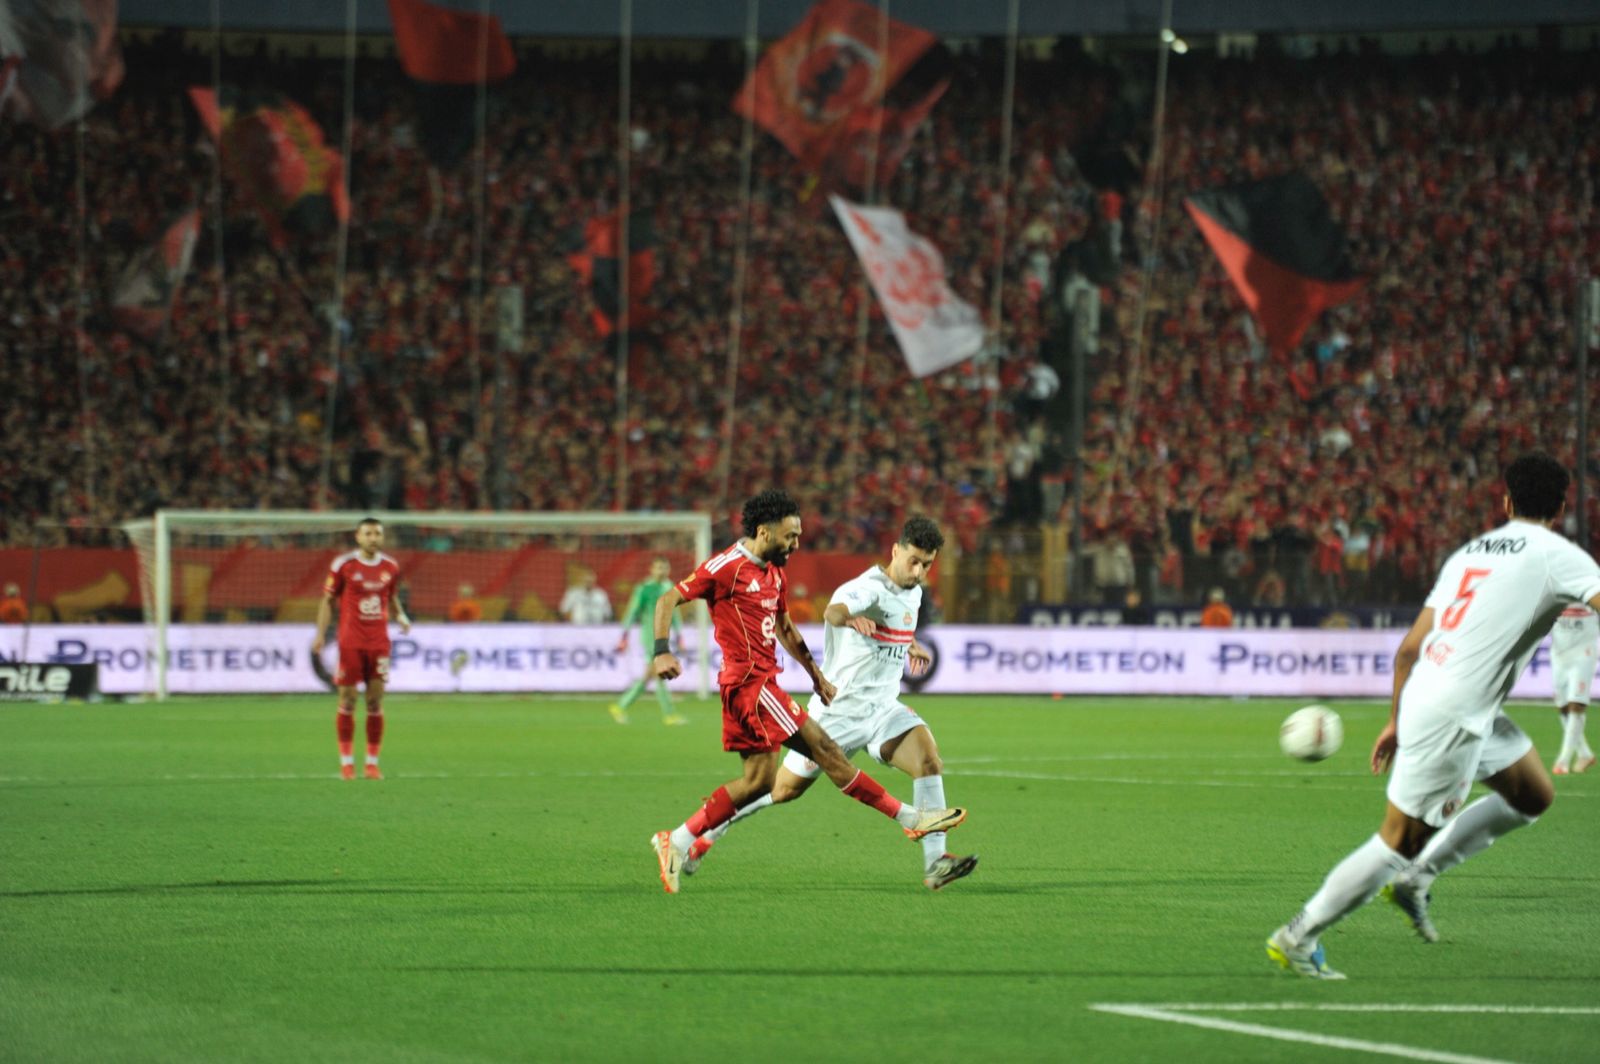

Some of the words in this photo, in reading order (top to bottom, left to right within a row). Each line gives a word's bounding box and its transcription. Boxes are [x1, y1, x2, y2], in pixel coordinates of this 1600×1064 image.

[1441, 568, 1493, 631] 5
[956, 641, 1184, 673] PROMETEON
[1210, 642, 1392, 675] PROMETE
